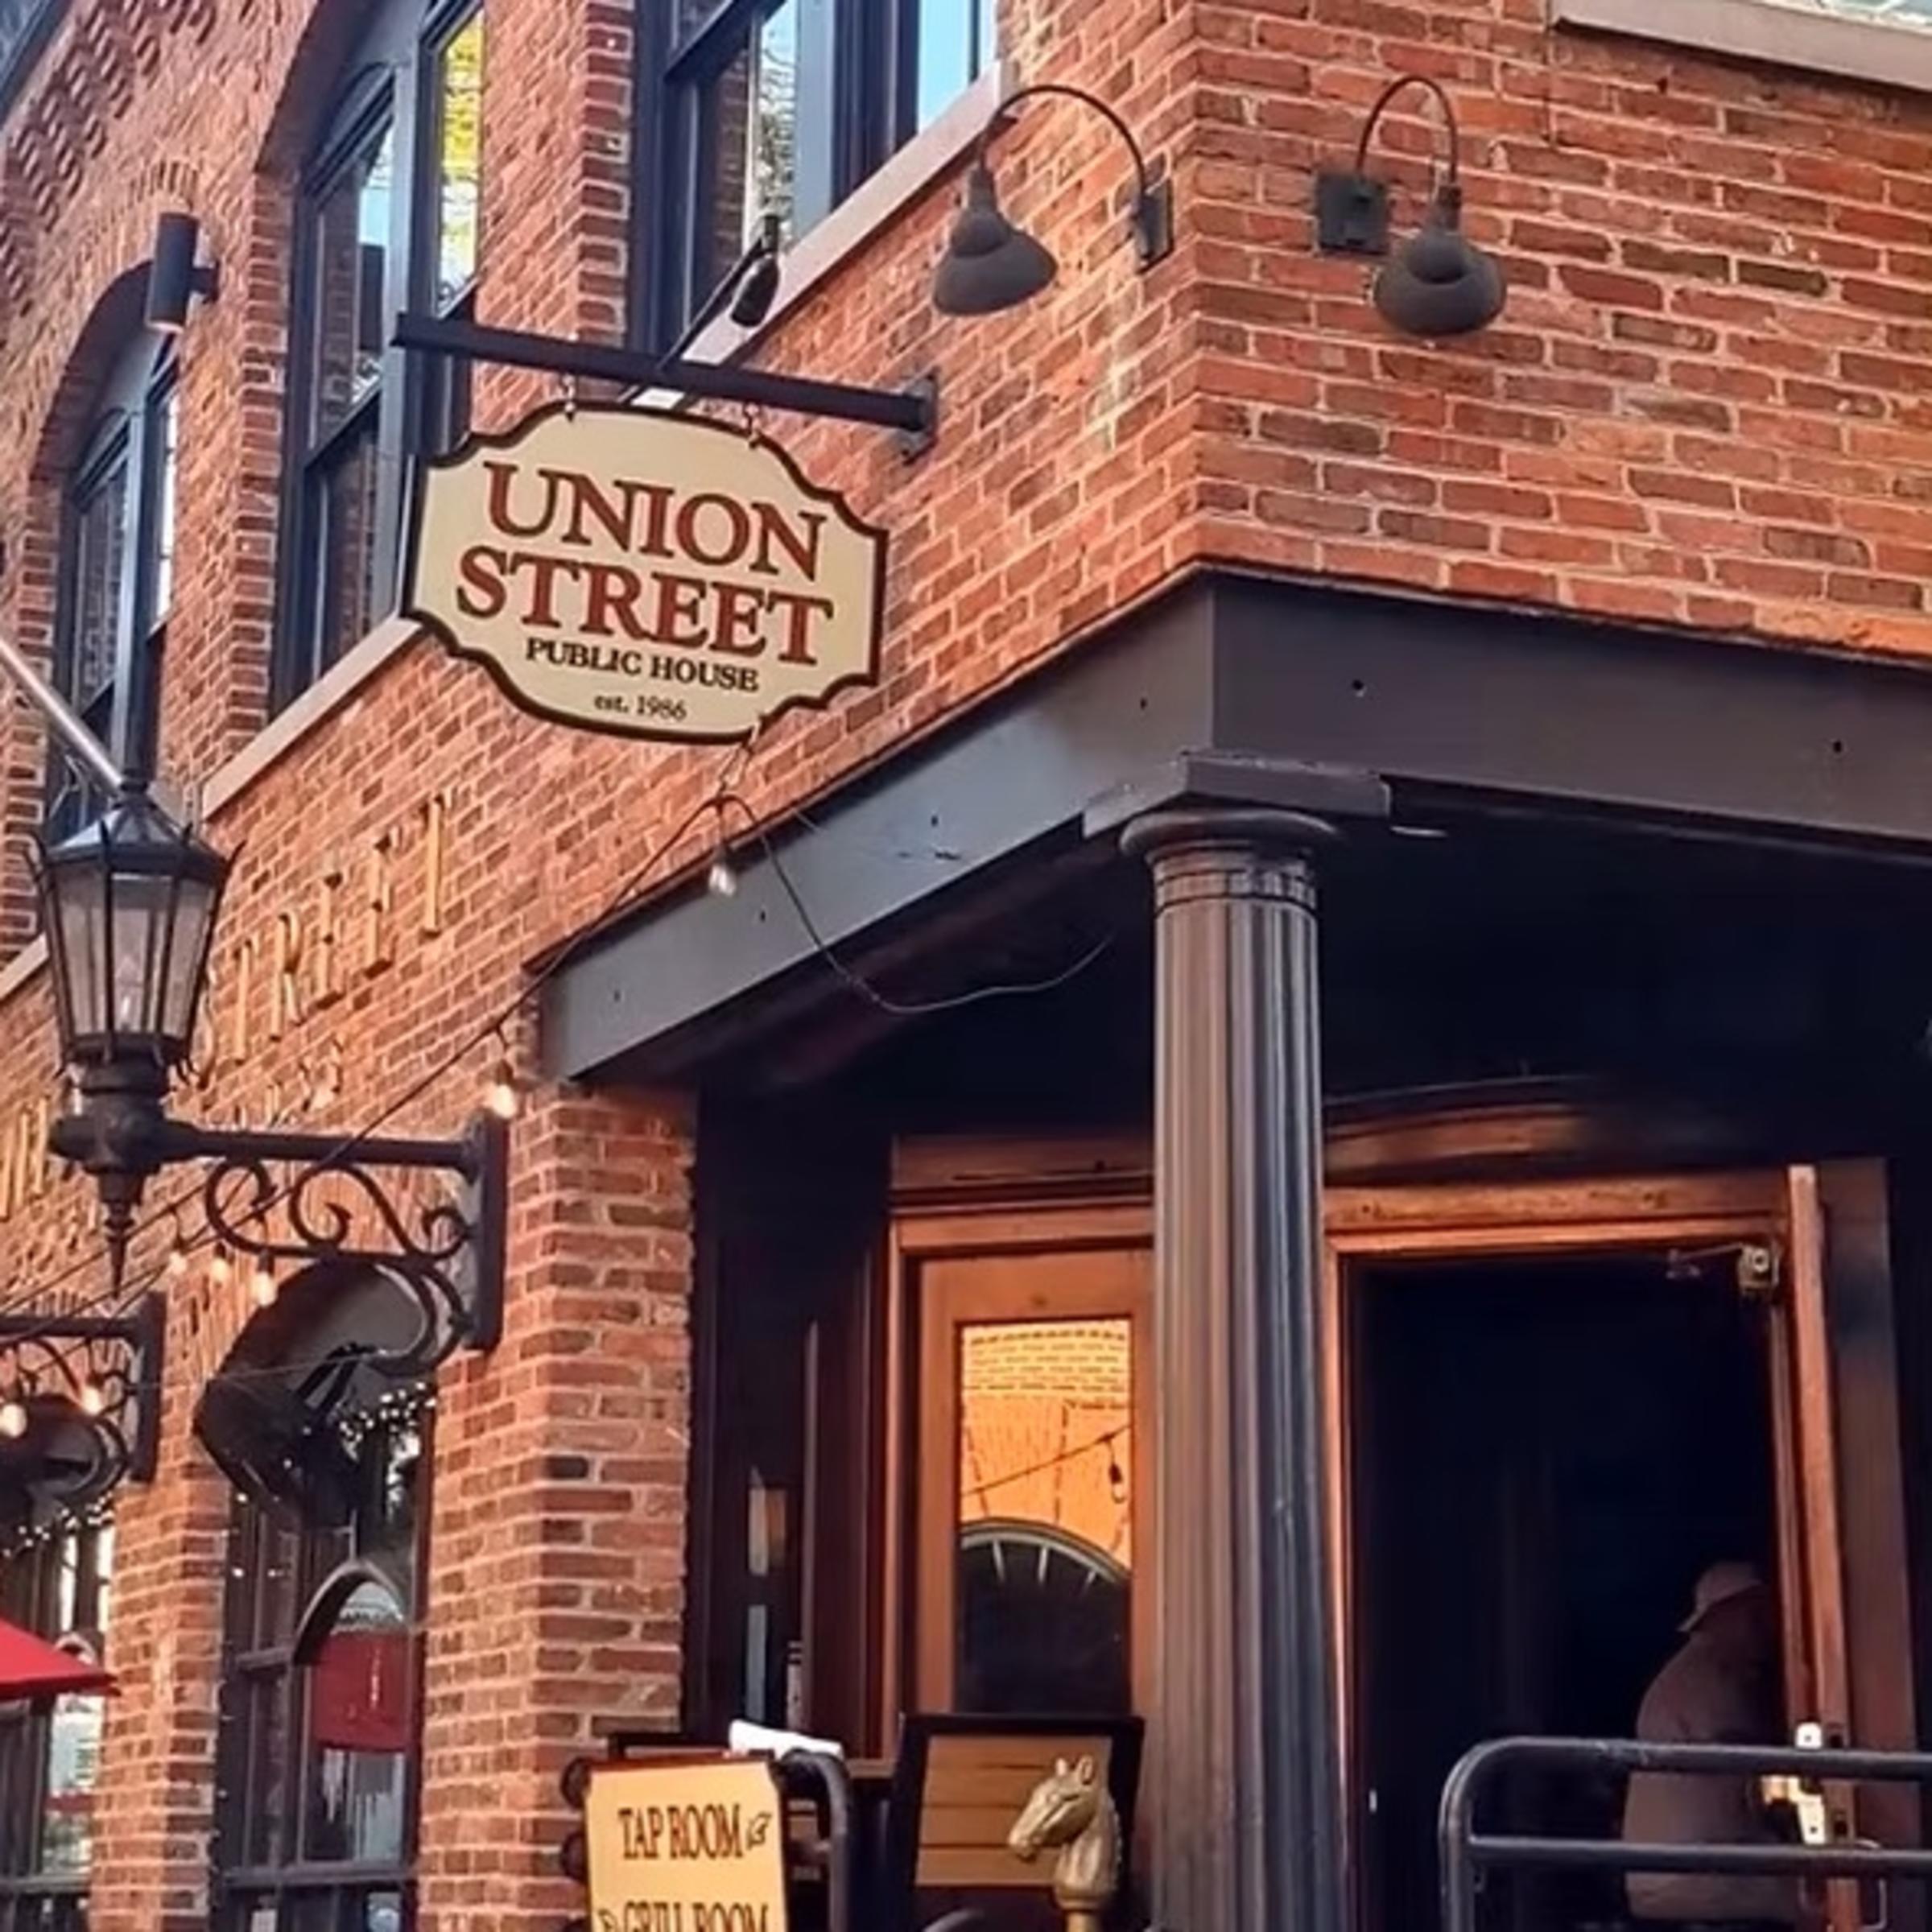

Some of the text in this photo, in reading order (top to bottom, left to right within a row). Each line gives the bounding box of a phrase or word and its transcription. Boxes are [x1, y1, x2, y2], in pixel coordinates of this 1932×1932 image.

[483, 461, 827, 581] UNION
[456, 546, 833, 666] STREET
[526, 637, 759, 692] PUBLIC HOUSE
[594, 695, 687, 721] est. 1986
[617, 1802, 743, 1860] TAP ROOM
[691, 1901, 768, 1932] ROOM
